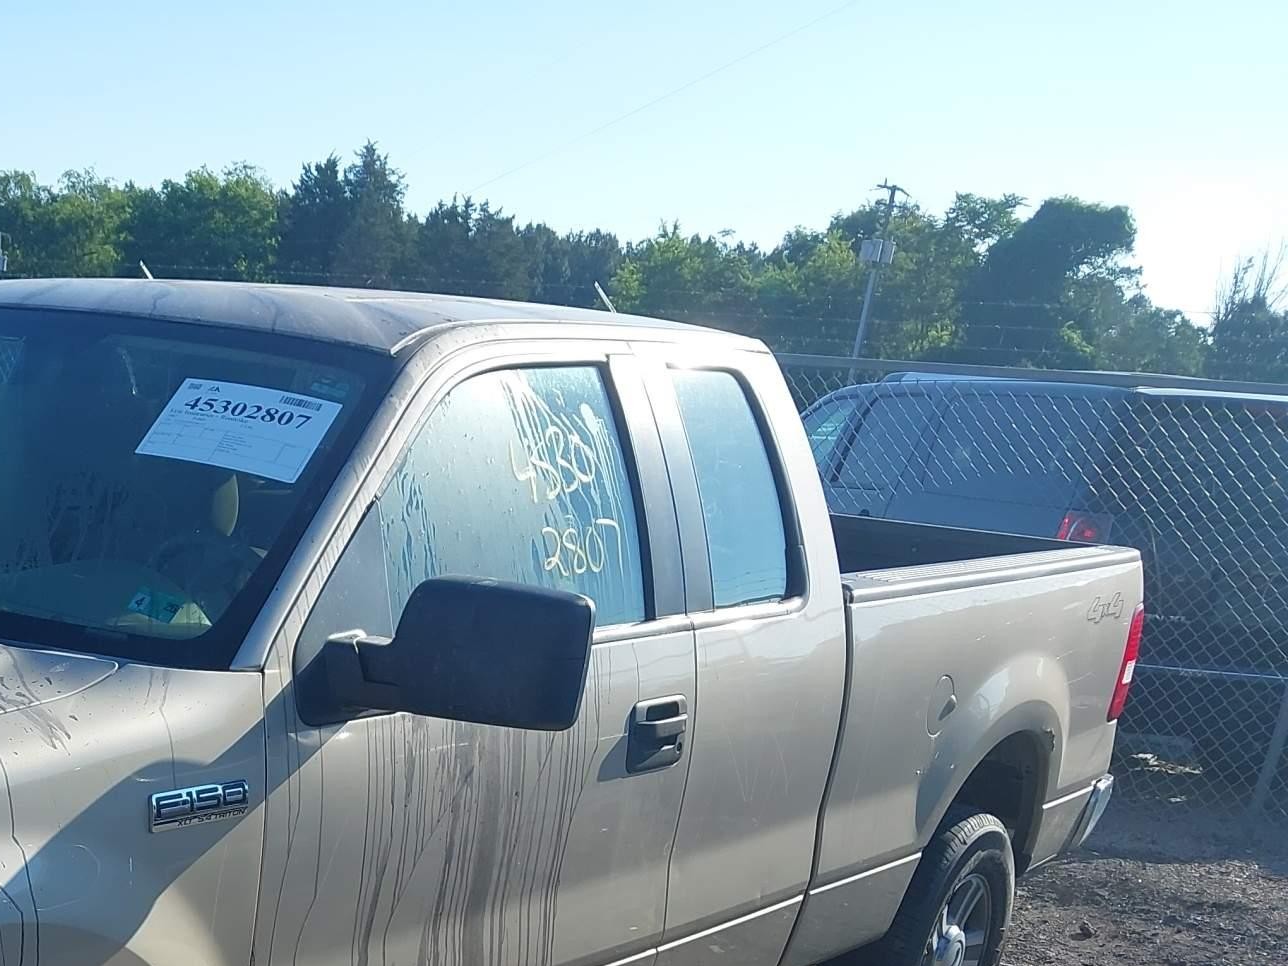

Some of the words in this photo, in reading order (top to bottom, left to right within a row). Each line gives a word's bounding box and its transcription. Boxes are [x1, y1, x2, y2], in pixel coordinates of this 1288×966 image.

[184, 395, 313, 430] 45302807
[509, 426, 596, 503] 4530
[540, 519, 624, 576] 2807
[1087, 591, 1125, 624] 4x4
[177, 818, 193, 827] XLT
[213, 807, 248, 820] TRITON
